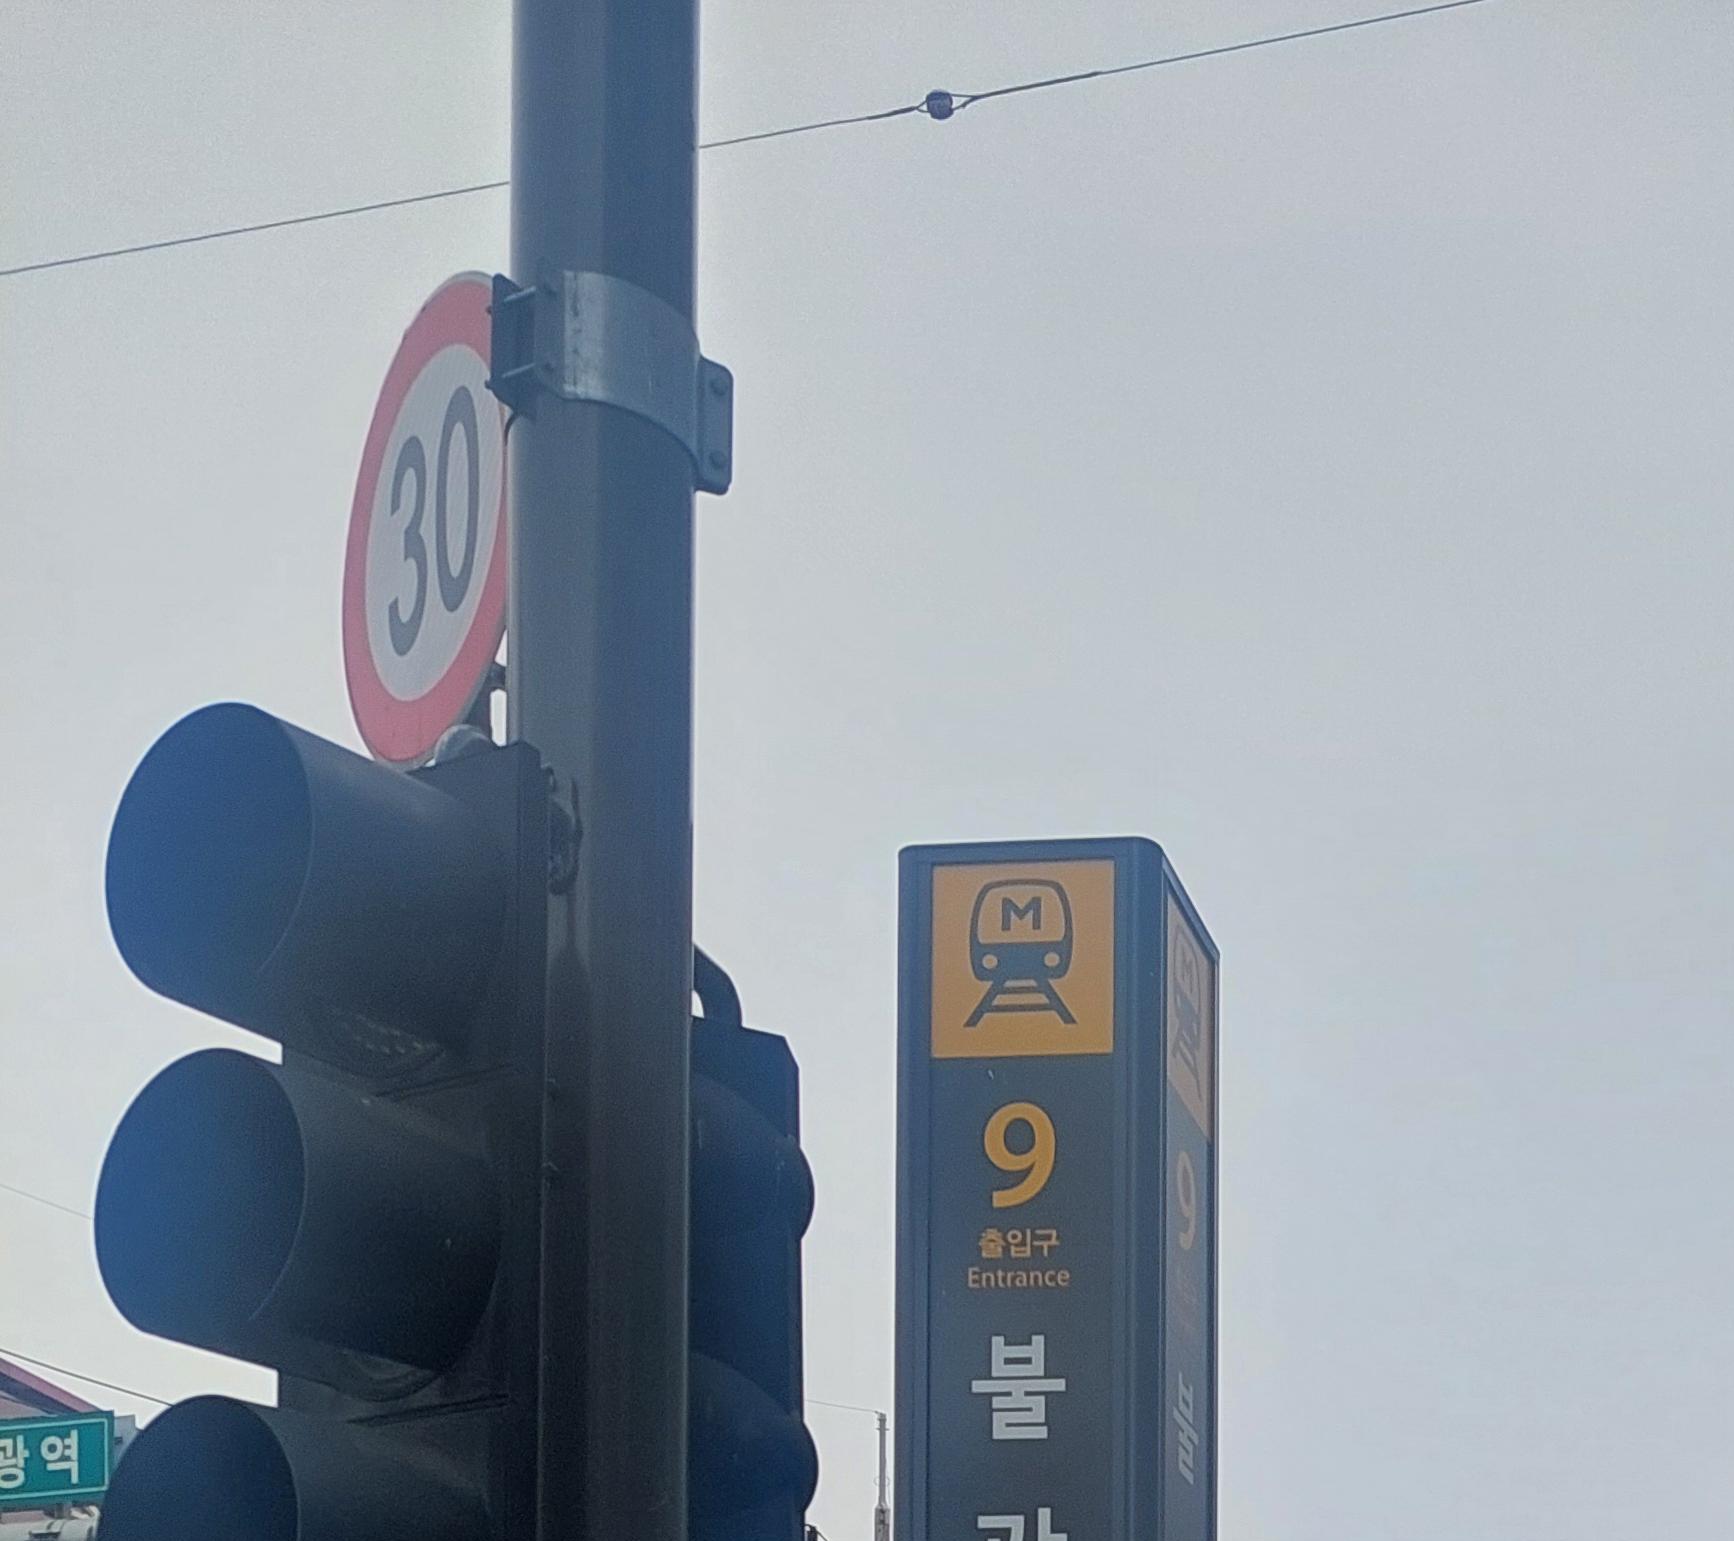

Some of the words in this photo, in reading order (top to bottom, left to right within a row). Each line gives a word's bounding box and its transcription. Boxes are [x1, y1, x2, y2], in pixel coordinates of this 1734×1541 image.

[388, 384, 481, 658] 30
[983, 1101, 1056, 1208] 9
[967, 1267, 1071, 1288] Entrance
[978, 1227, 1060, 1259] 출입구
